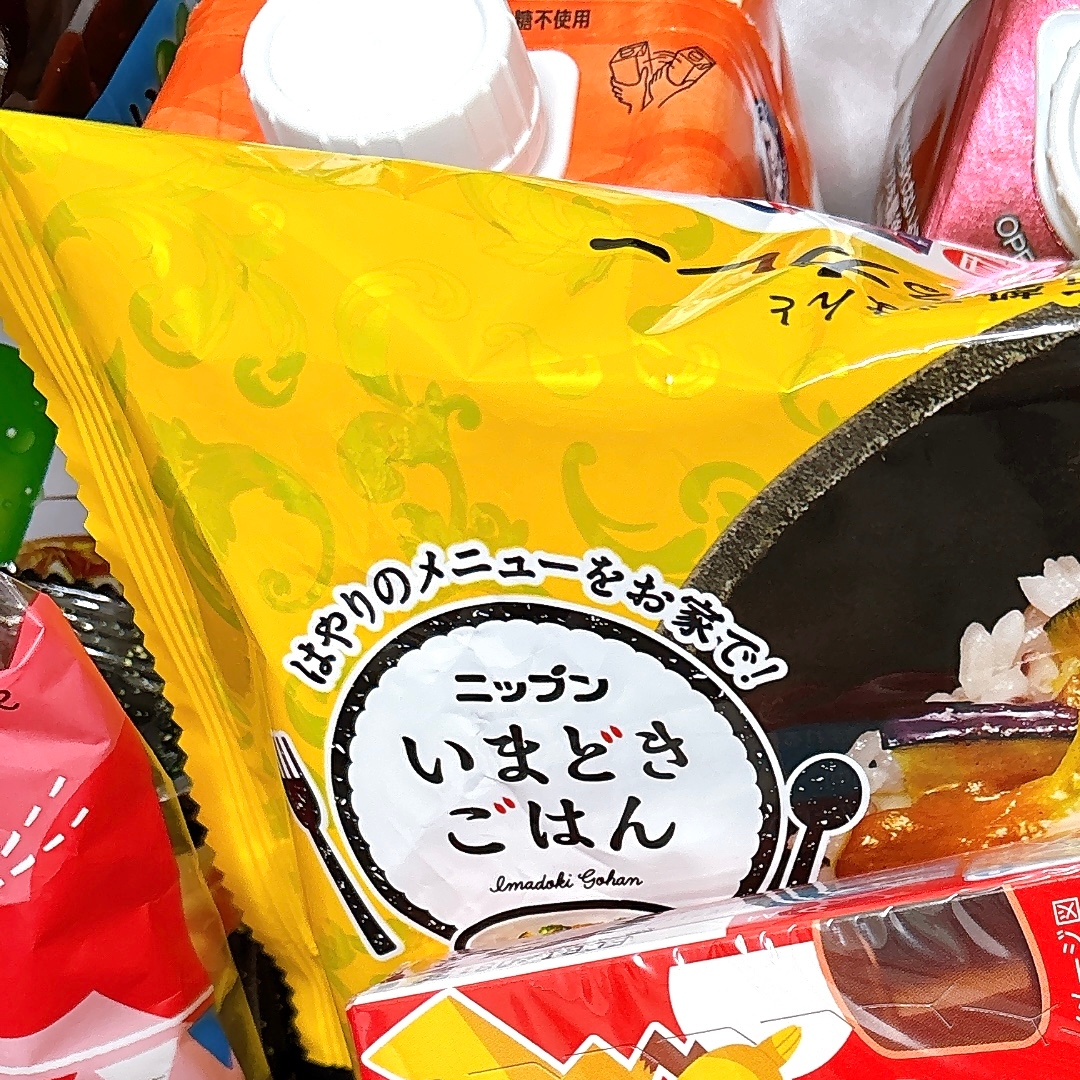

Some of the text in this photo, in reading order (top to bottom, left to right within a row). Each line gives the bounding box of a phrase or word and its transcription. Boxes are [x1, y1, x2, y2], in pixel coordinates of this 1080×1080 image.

[289, 547, 780, 689] はやりのメニューをお家で!
[454, 664, 609, 702] ニップン
[402, 720, 689, 784] いまどき
[448, 796, 676, 855] ごはん
[489, 868, 644, 893] Imadoki Gohan
